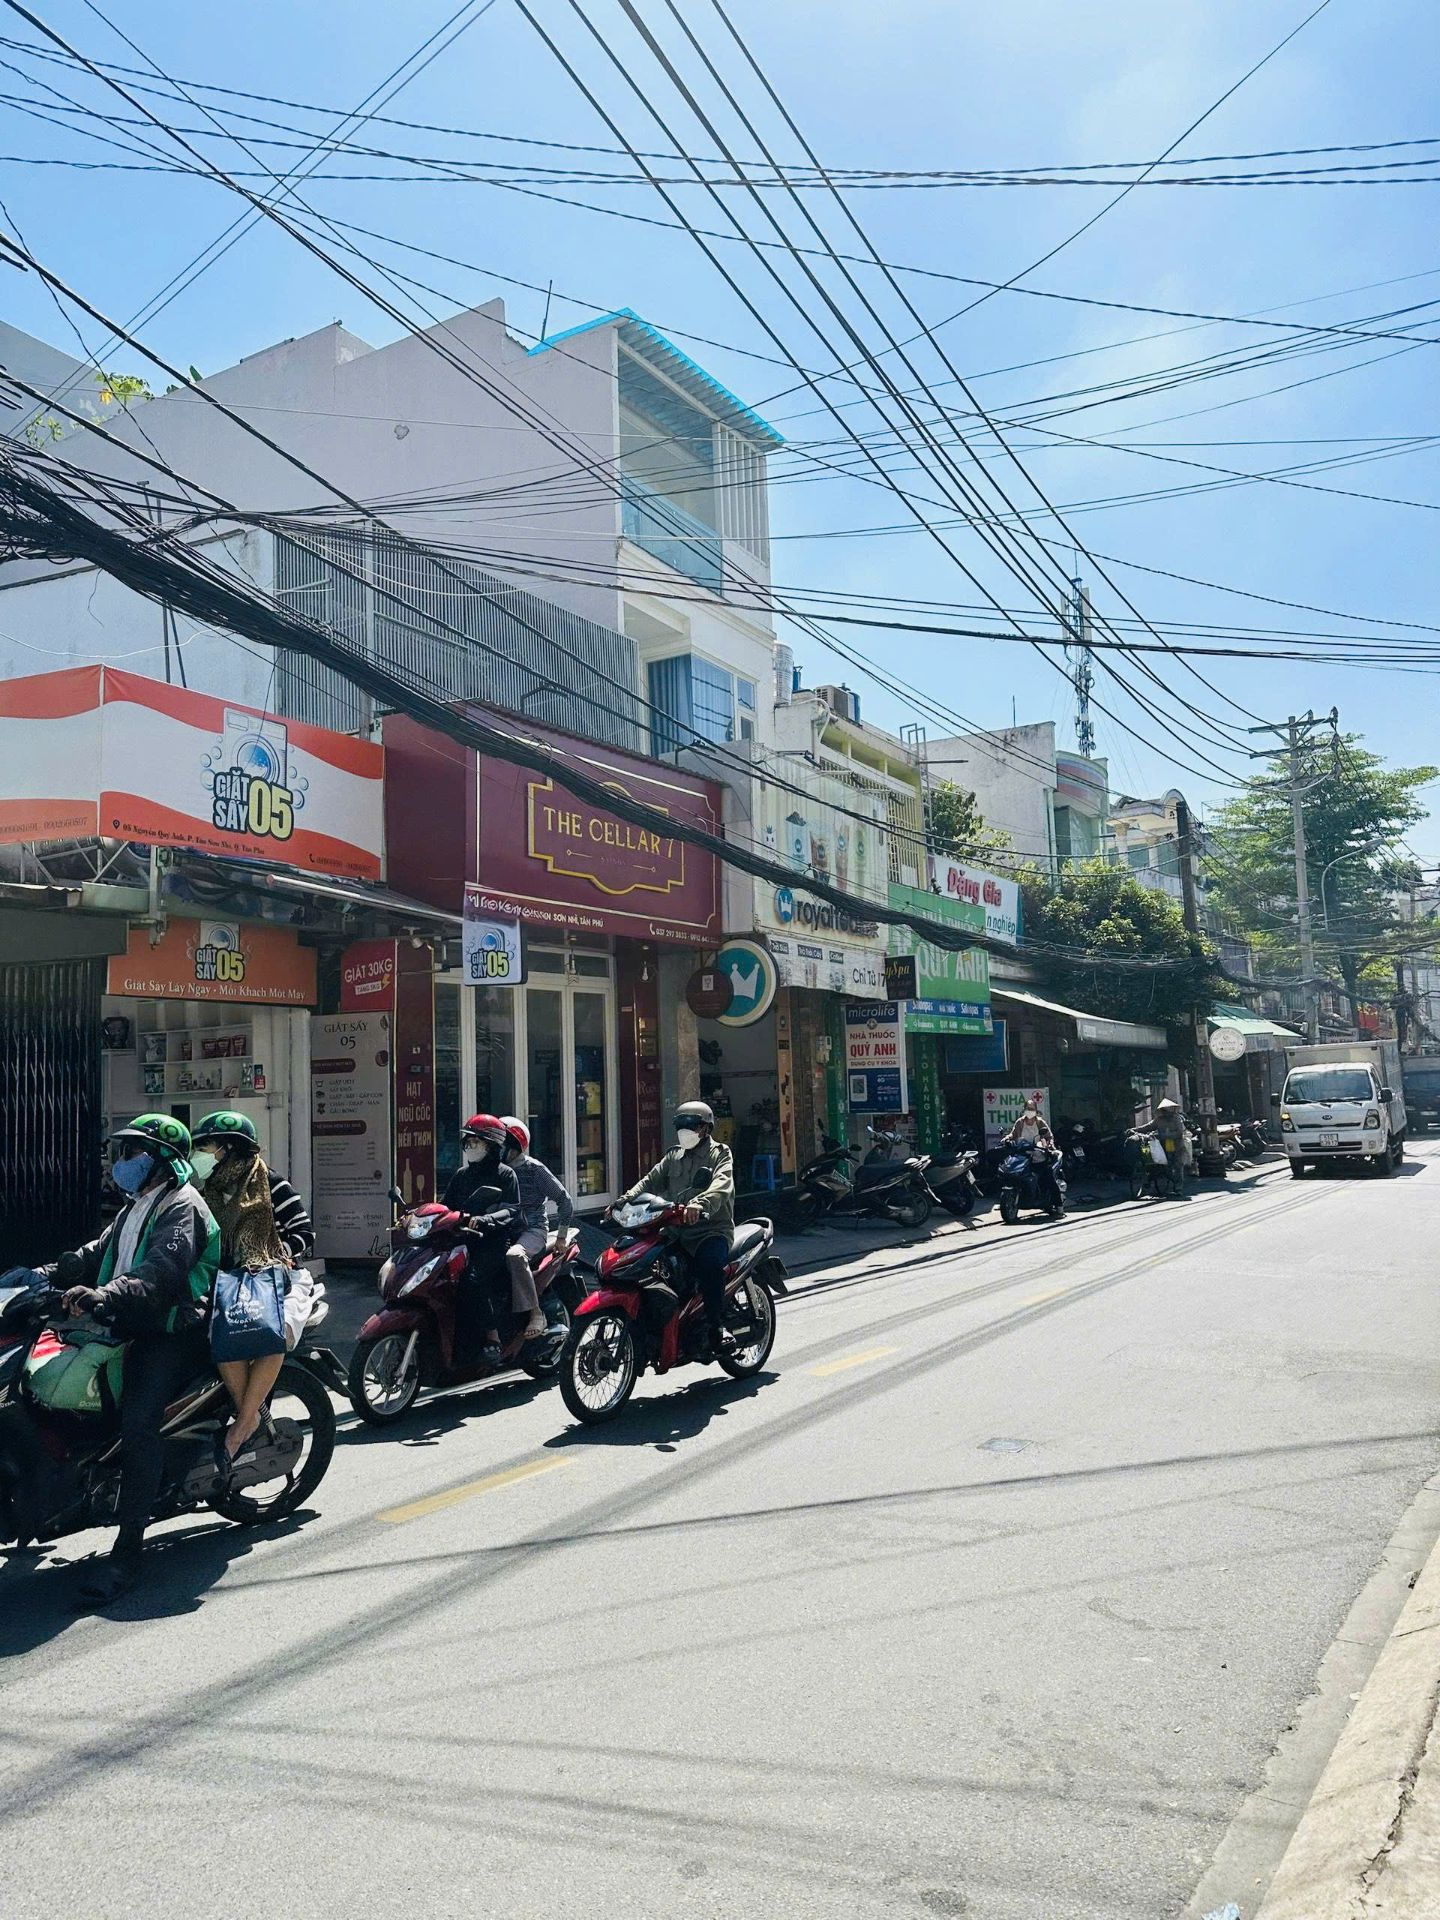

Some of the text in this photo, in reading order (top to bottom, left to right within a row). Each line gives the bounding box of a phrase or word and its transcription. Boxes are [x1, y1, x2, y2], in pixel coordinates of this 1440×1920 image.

[248, 779, 292, 839] 05
[543, 806, 583, 838] THE
[588, 817, 661, 856] CELLAR
[947, 866, 1002, 907] Đặng Gia
[216, 951, 245, 982] 05
[368, 958, 393, 977] 30KG
[487, 950, 509, 978] 05
[848, 1005, 896, 1019] microlife
[340, 1035, 356, 1049] 05
[873, 1043, 897, 1056] ANH
[406, 1081, 422, 1099] HẠT
[999, 1089, 1026, 1106] NHÀ
